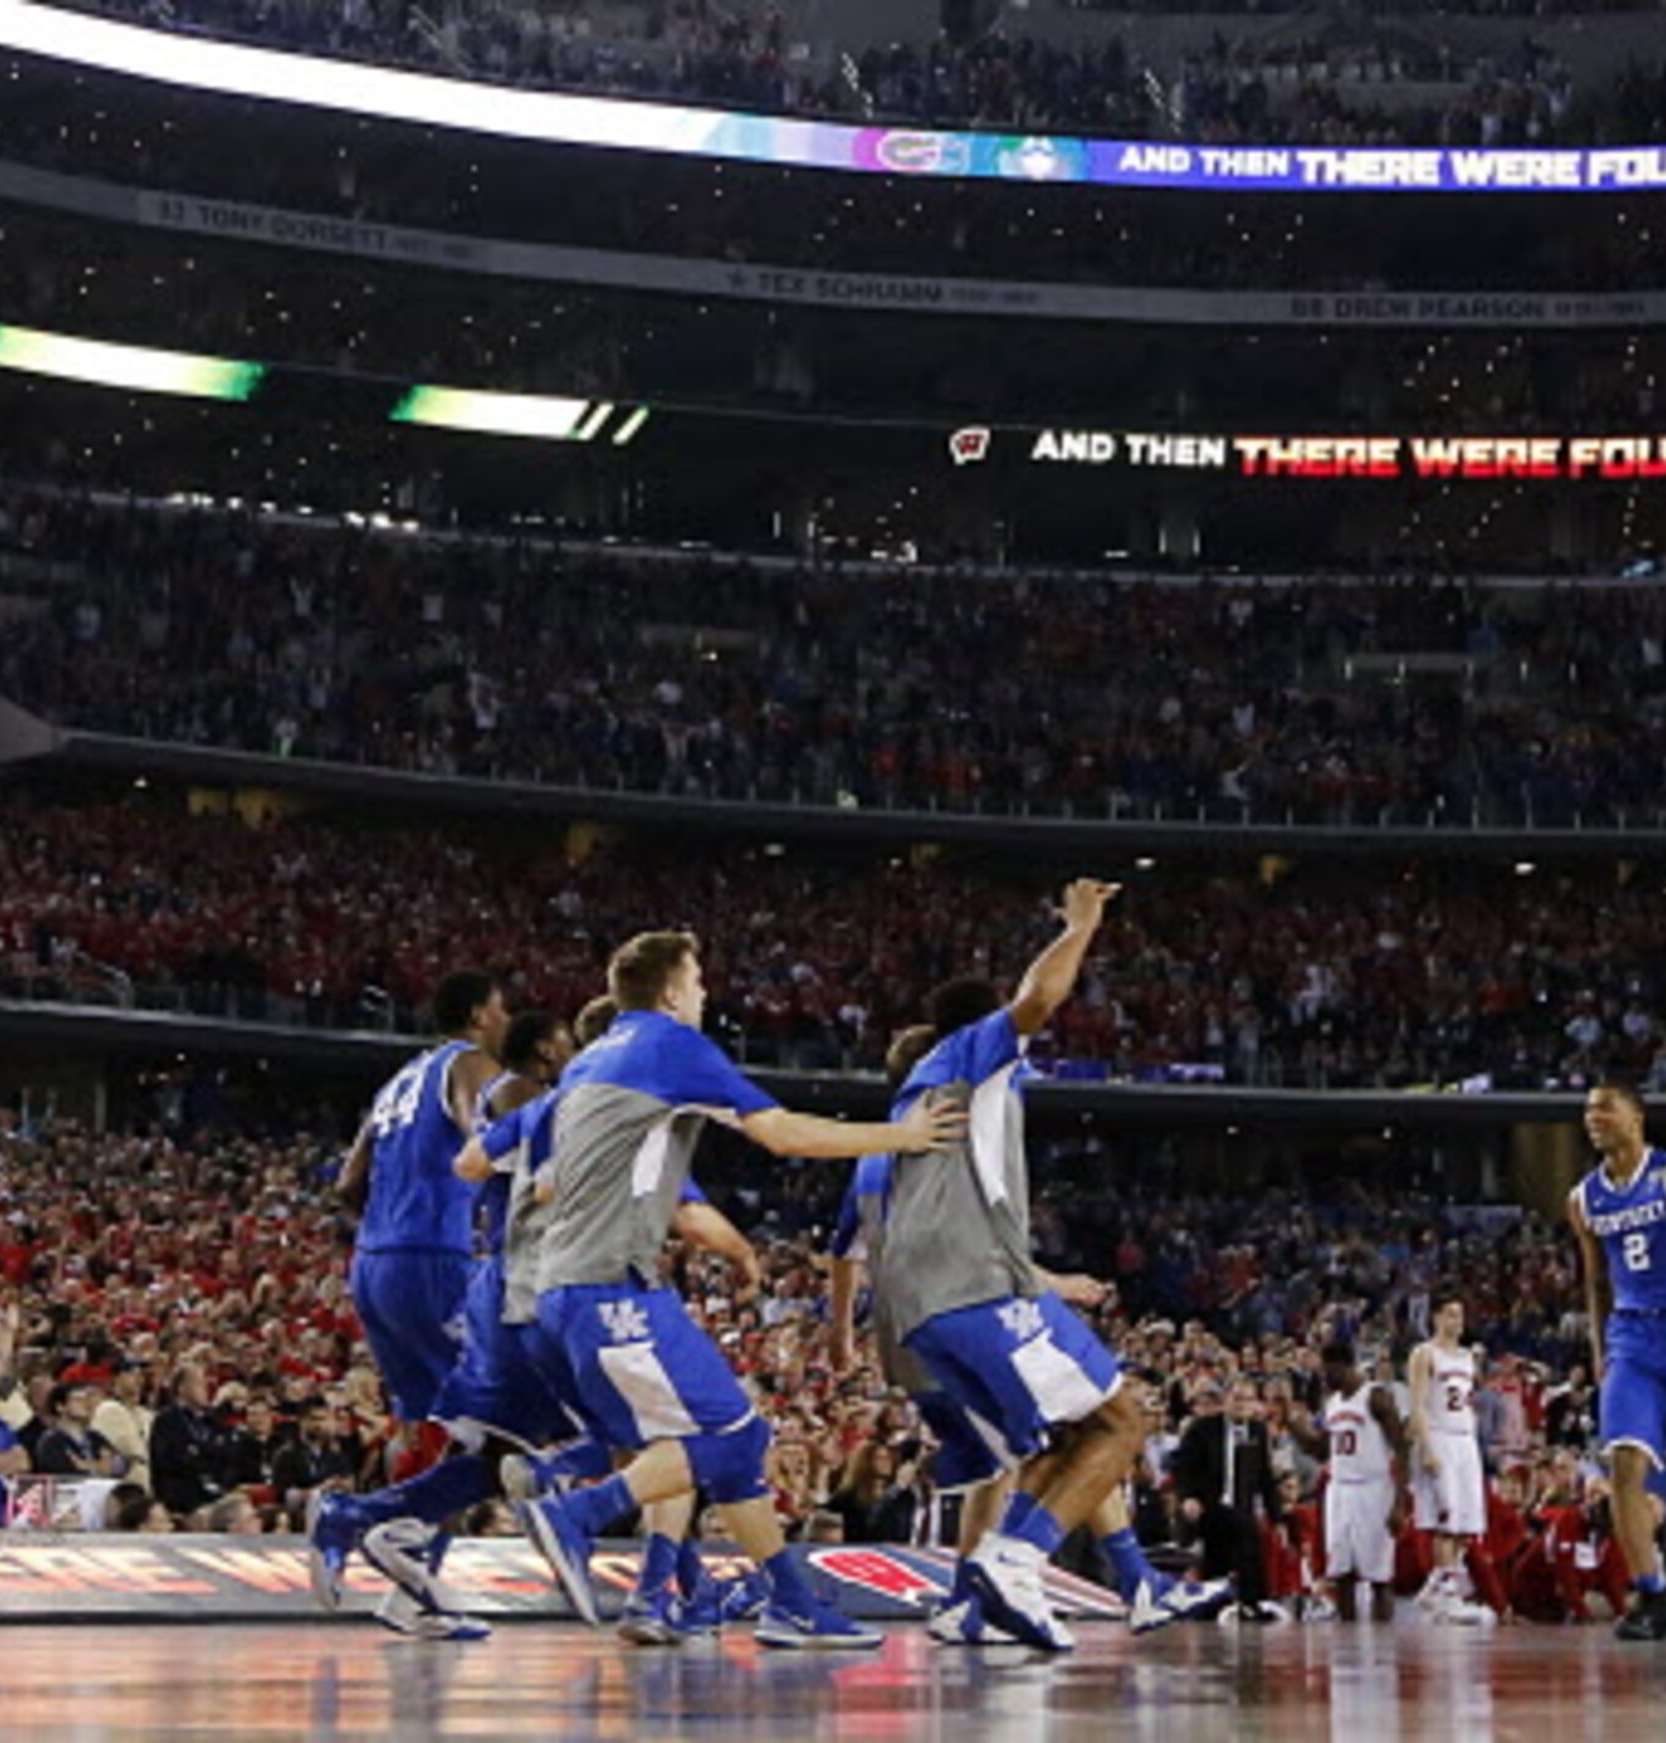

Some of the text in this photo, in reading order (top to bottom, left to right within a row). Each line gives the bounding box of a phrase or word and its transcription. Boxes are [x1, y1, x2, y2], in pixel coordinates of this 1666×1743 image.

[1119, 146, 1192, 172] AND
[1199, 150, 1289, 177] THEN
[1295, 150, 1443, 186] THERE
[1452, 149, 1581, 186] WERE
[198, 205, 263, 231] TONY
[271, 215, 388, 251] DORSETT
[757, 273, 805, 293] TEX
[817, 277, 943, 305] SCHRAMM
[1334, 297, 1410, 318] DREW
[1419, 297, 1544, 319] PEARSON
[1031, 429, 1116, 462] AND
[1125, 433, 1227, 467] THEN
[1234, 435, 1401, 477] THERE
[1409, 435, 1561, 478] WERE
[372, 1063, 425, 1138] 44
[1623, 1233, 1651, 1271] 2
